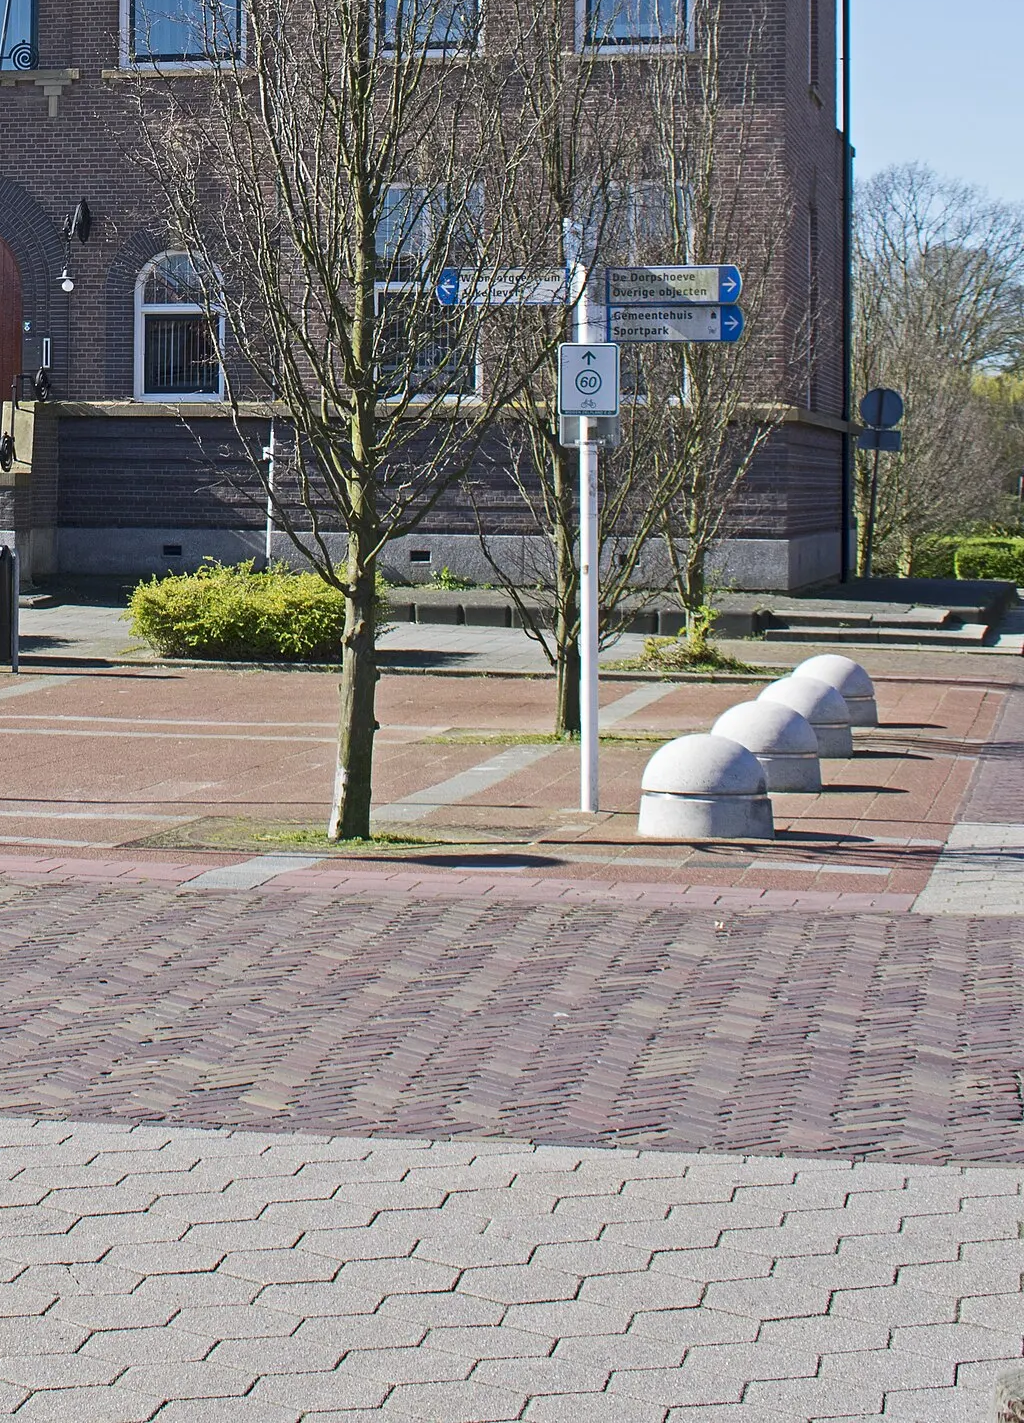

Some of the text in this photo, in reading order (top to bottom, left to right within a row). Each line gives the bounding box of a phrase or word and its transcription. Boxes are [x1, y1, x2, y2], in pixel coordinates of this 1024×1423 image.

[612, 272, 696, 284] De Dorpshoeve
[612, 286, 707, 299] Overige objecten
[613, 310, 693, 320] Gemeentehuis
[613, 326, 670, 337] Sportpark
[580, 376, 597, 388] 60
